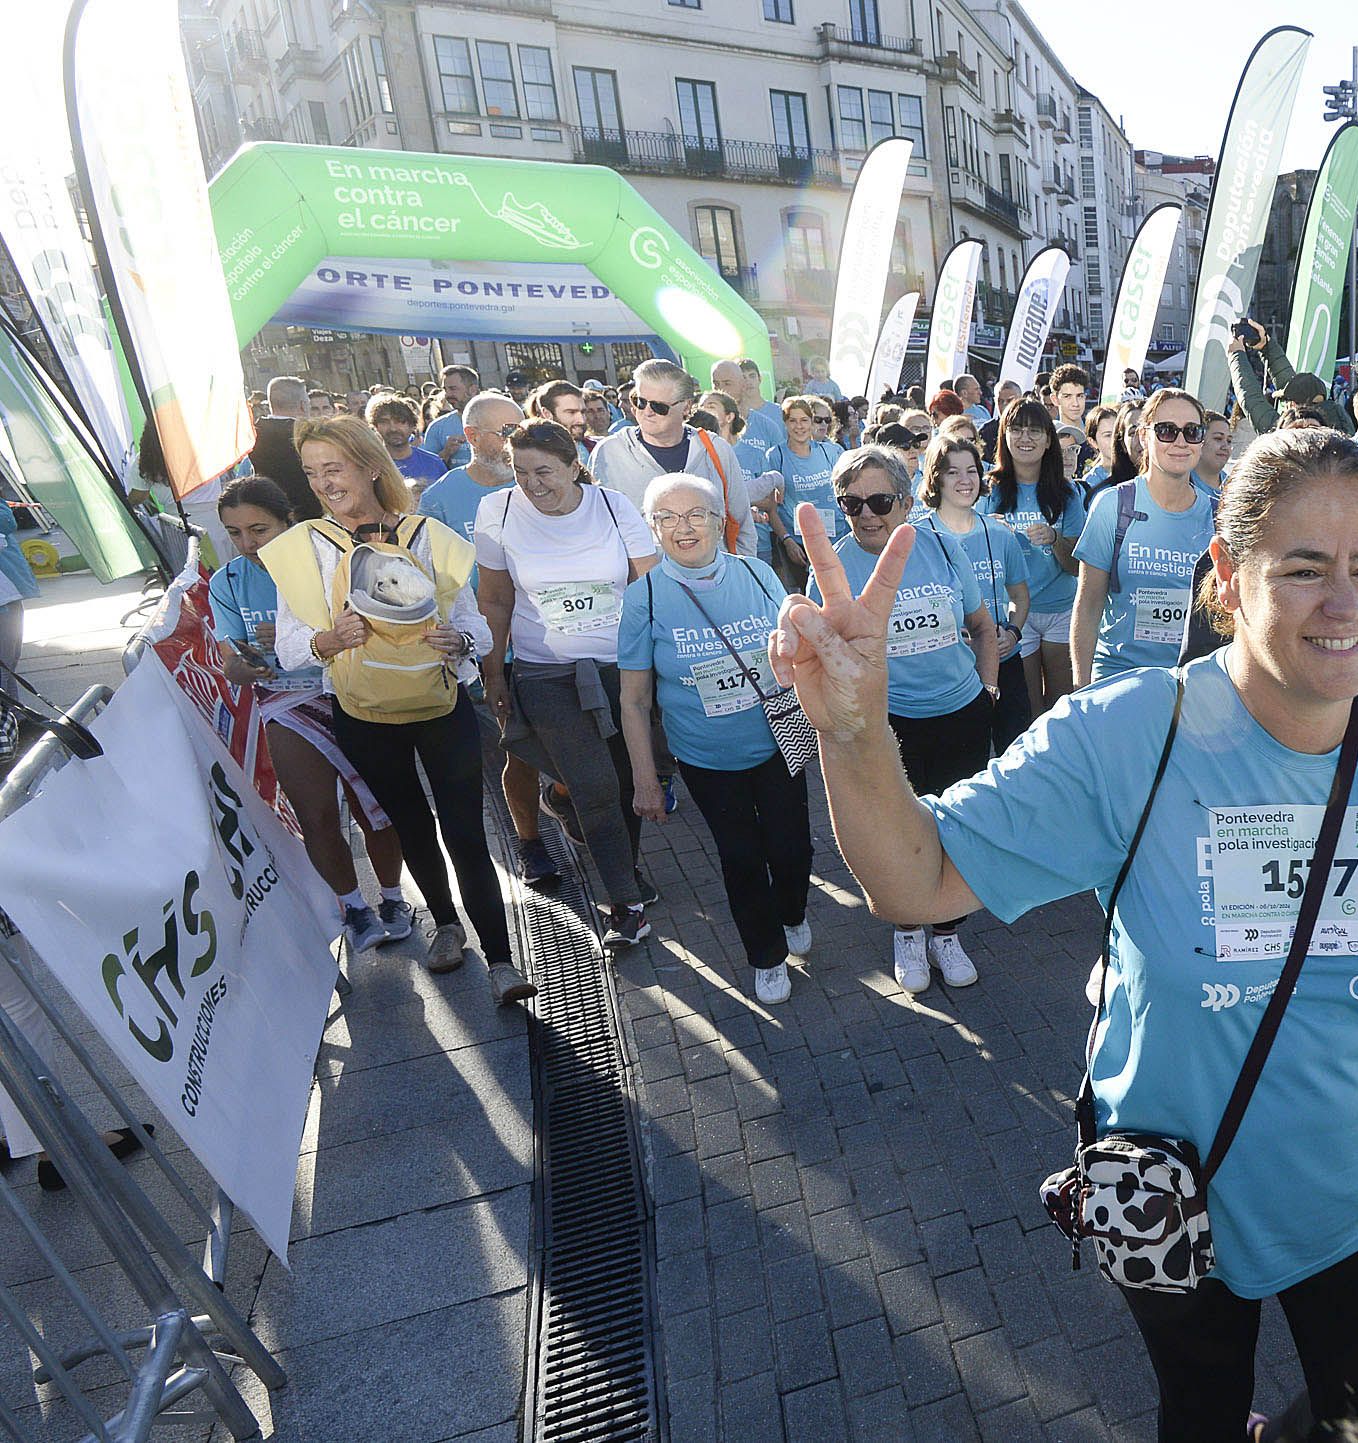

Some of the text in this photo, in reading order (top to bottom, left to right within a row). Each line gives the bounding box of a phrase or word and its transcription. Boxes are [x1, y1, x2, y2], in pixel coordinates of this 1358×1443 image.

[325, 159, 469, 186] En marcha
[334, 185, 424, 208] contra
[1215, 119, 1258, 263] Deputación
[1231, 127, 1274, 270] Pontevedra
[337, 207, 462, 233] el cáncer
[220, 226, 255, 265] ciación
[225, 244, 263, 287] spañola
[232, 267, 266, 302] contra
[270, 223, 304, 261] cáncer
[433, 278, 619, 300] PONTEVED
[1118, 242, 1154, 342] caser
[312, 328, 333, 336] Viajes
[313, 335, 334, 343] Deza
[1015, 291, 1049, 370] nugape
[1128, 542, 1203, 564] En marc
[240, 607, 263, 622] En
[562, 596, 594, 613] 807
[672, 614, 773, 642] En marcha
[893, 613, 940, 634] 1023
[716, 667, 761, 692] 1176
[1215, 811, 1295, 825] Pontevedra
[1216, 824, 1290, 838] en marcha
[1218, 838, 1250, 854] pola
[1199, 880, 1214, 912] pola
[1228, 903, 1255, 911] EDICIÓN
[1264, 942, 1281, 952] CHS
[101, 868, 218, 1063] CHS
[181, 974, 228, 1119] CONSTRUCCIONES
